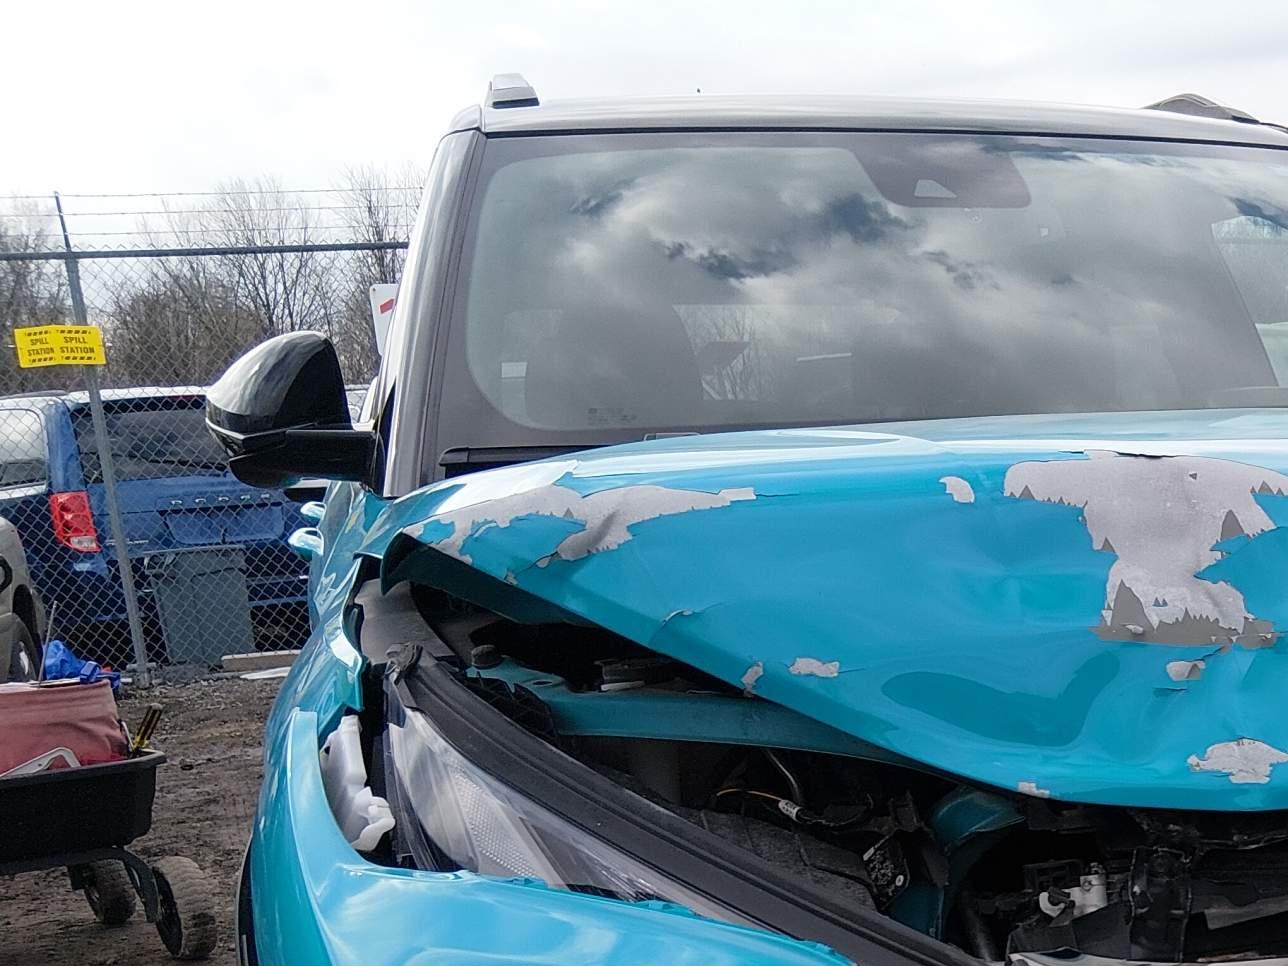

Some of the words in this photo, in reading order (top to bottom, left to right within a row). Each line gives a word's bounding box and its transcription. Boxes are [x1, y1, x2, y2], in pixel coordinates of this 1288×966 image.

[30, 337, 49, 346] SPILL
[63, 336, 88, 344] SPILL
[27, 347, 55, 357] STATION
[60, 346, 95, 354] STATION
